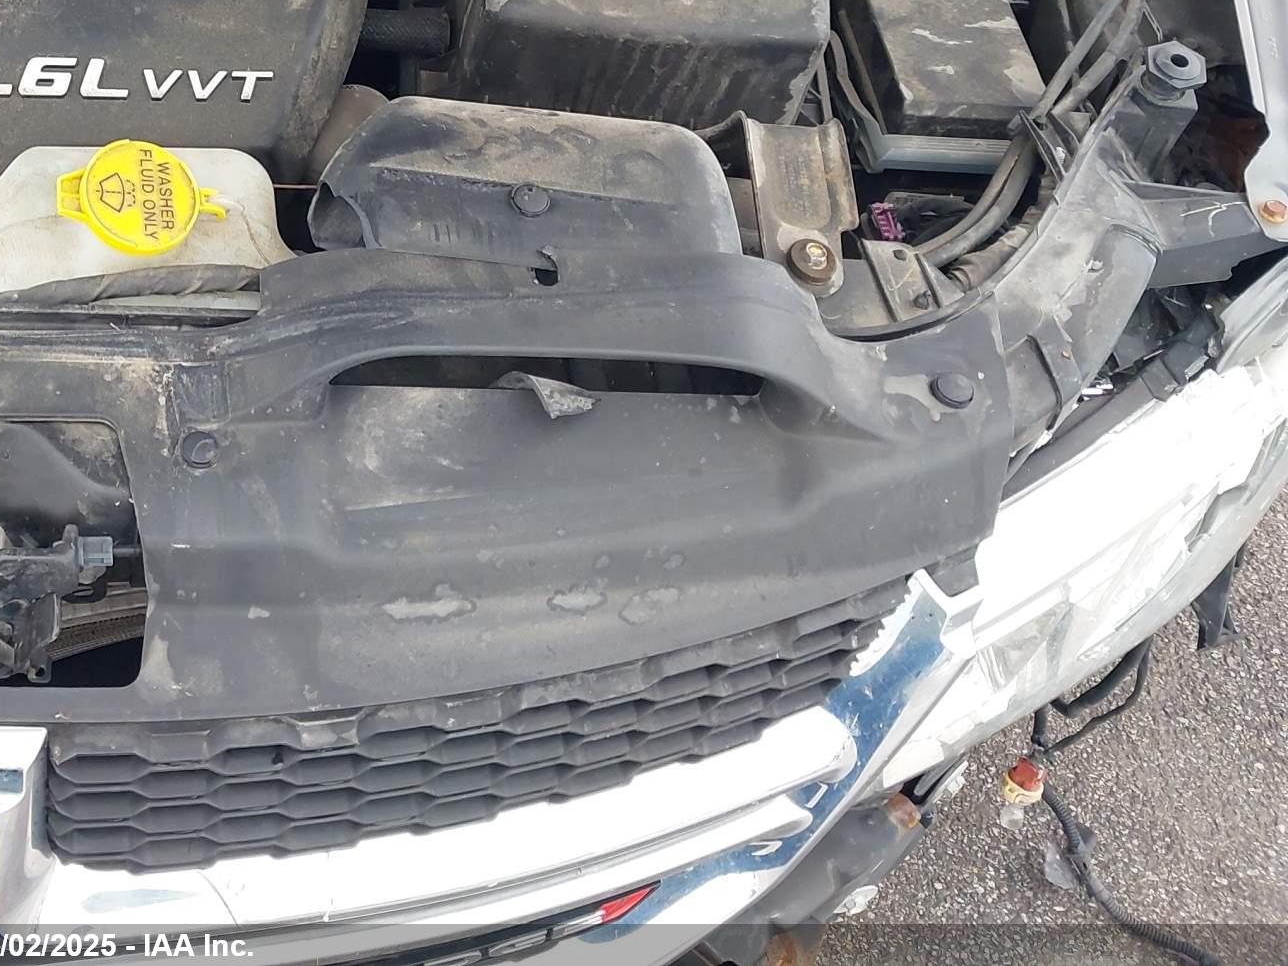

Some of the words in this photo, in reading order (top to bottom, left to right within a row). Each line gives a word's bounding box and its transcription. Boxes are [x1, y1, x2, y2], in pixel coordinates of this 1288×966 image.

[143, 69, 274, 101] VVT
[139, 148, 155, 194] FLUID
[157, 161, 175, 231] WASHER
[142, 199, 160, 241] ONLY
